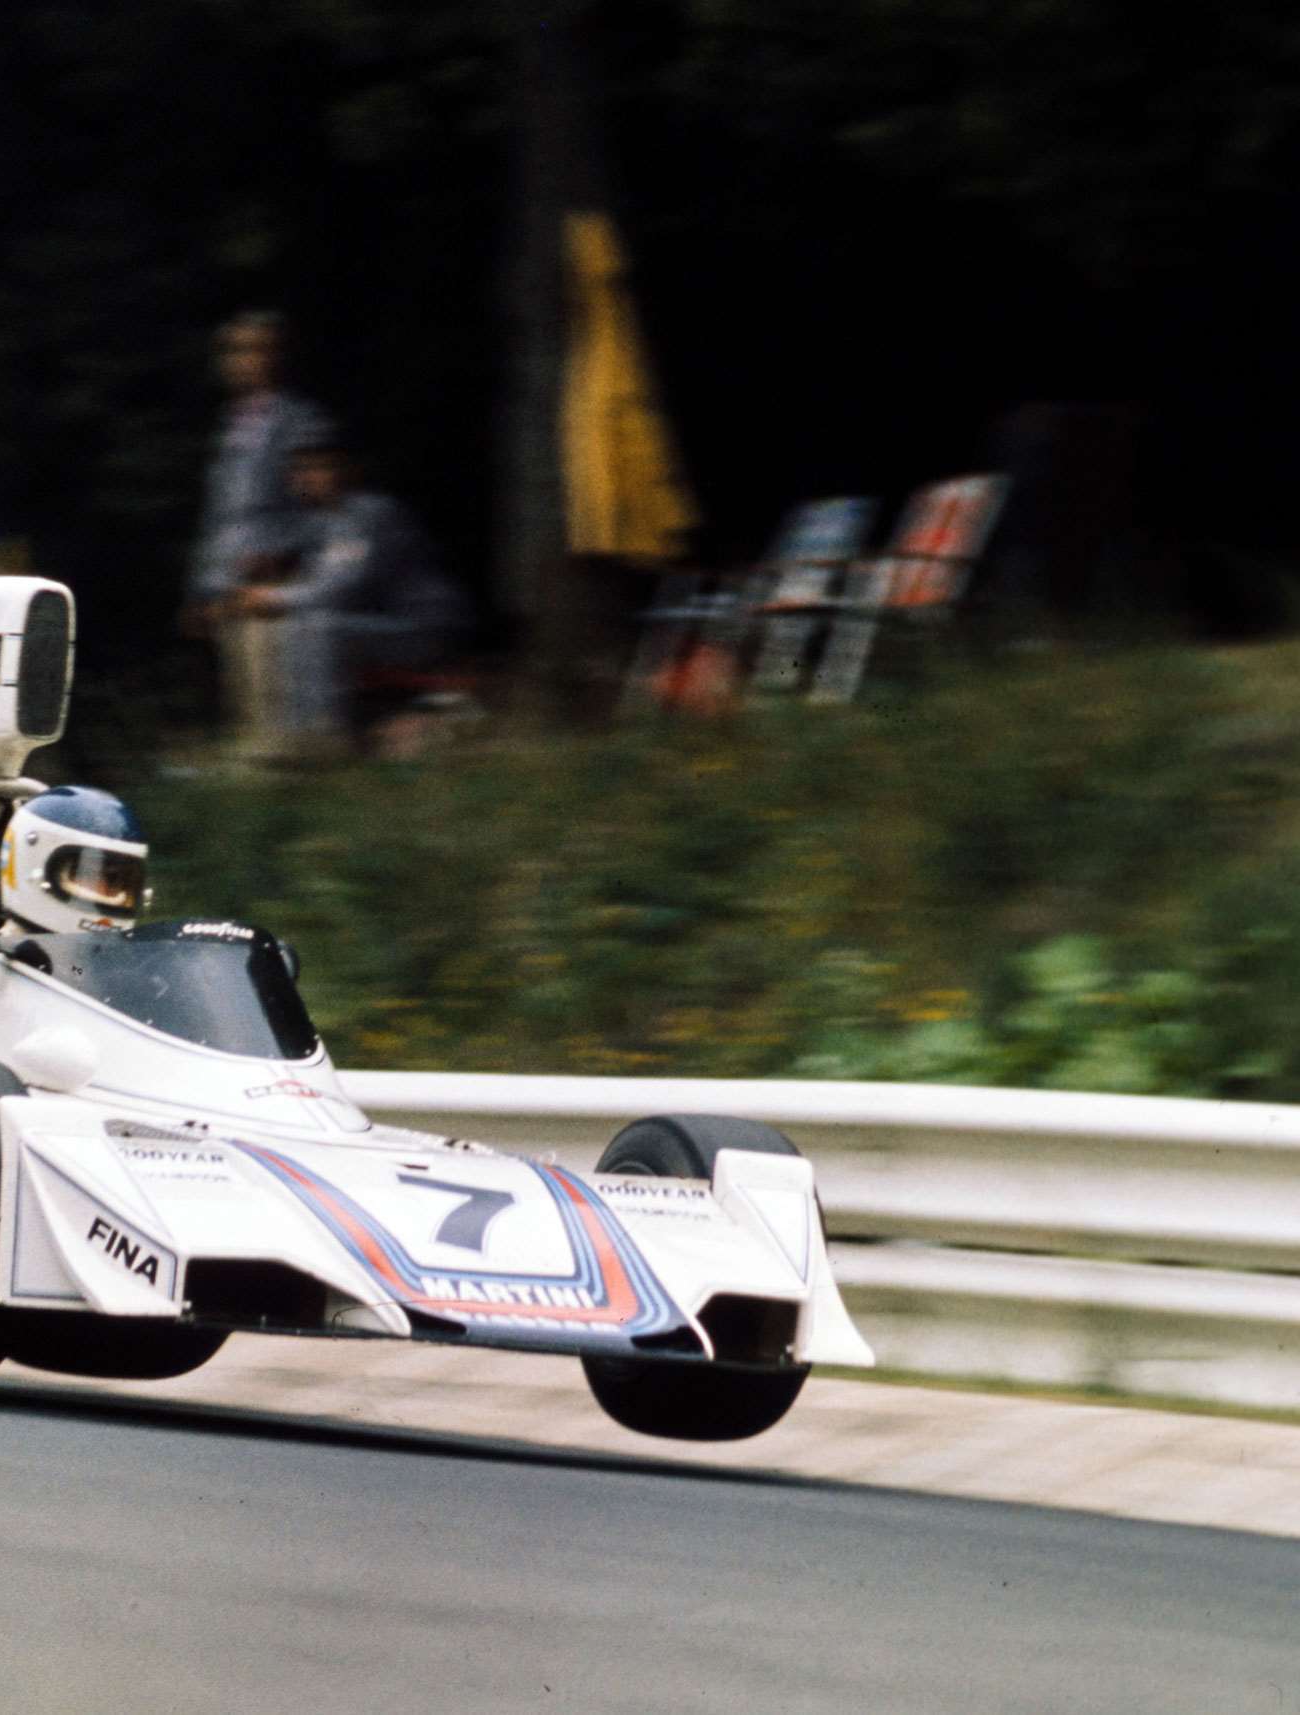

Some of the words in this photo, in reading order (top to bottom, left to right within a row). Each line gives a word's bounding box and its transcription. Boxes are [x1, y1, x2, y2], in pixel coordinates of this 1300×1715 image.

[120, 1148, 224, 1162] OODYEAR
[599, 1184, 705, 1199] OODYEAR
[397, 1174, 516, 1252] 7
[87, 1217, 159, 1286] FINA
[419, 1276, 596, 1309] MARTINI
